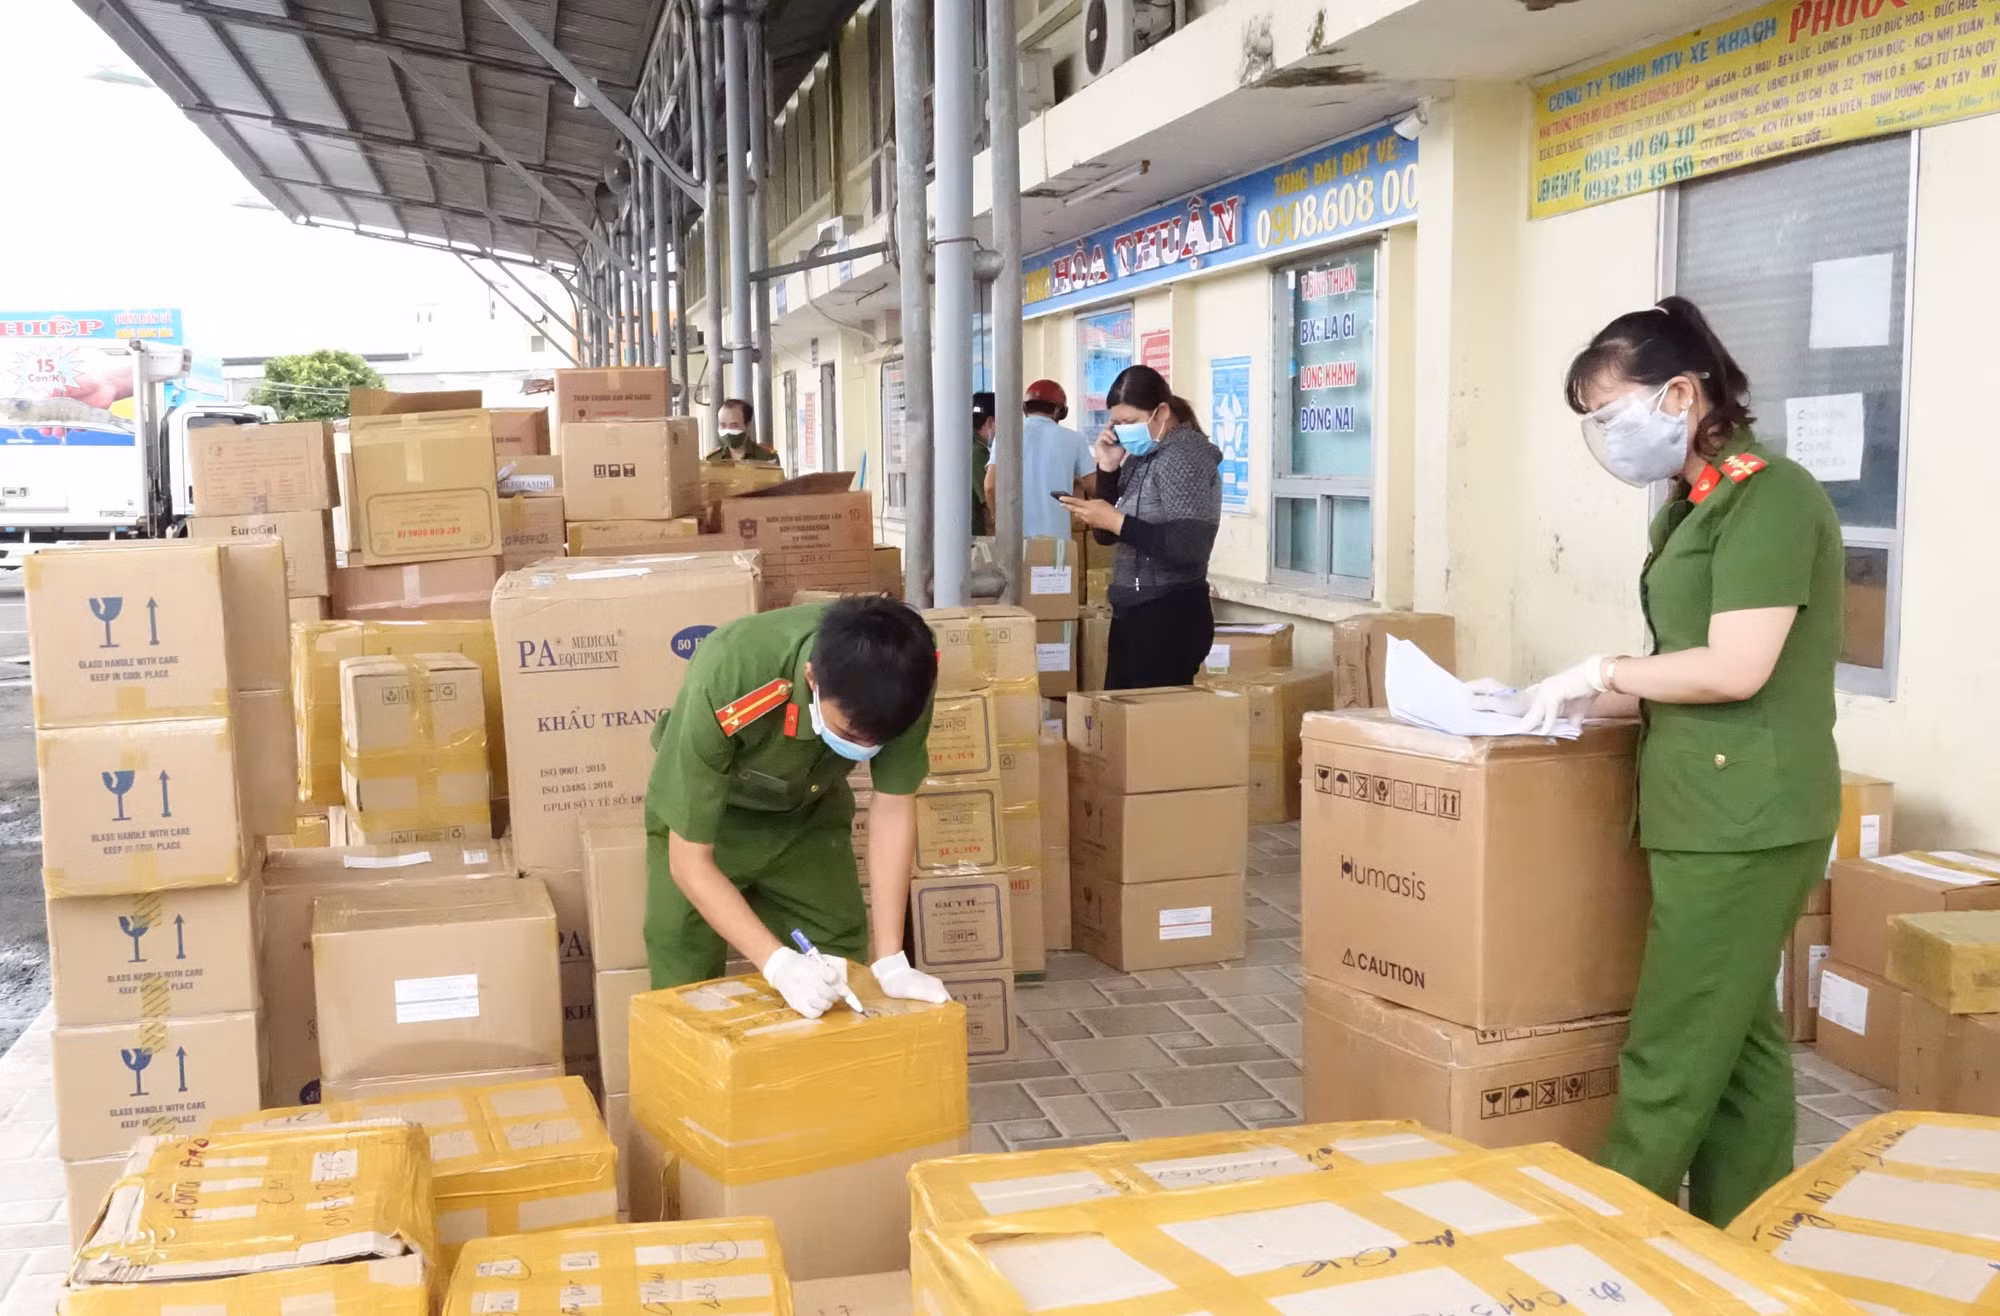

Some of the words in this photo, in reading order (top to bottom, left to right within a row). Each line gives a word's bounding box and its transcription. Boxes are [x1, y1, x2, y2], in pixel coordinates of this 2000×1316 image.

[1586, 79, 1602, 98] TY
[1608, 64, 1646, 92] TNHH
[1651, 48, 1683, 79] MTV
[1689, 40, 1710, 65] XE
[1257, 176, 1374, 250] 0908.608
[1113, 196, 1240, 271] THUẬN
[1323, 316, 1339, 341] LA
[1343, 312, 1355, 339] GI
[36, 358, 55, 373] 15
[27, 371, 67, 385] Con/Kg
[1301, 366, 1323, 390] LONG
[1335, 407, 1355, 432] NAI
[230, 523, 278, 538] EuroGel
[518, 638, 558, 669] PA
[571, 634, 619, 649] MEDICAL
[677, 639, 692, 651] 50
[78, 659, 103, 670] GLASS
[104, 657, 135, 668] HANDLE
[136, 655, 157, 667] WITH
[158, 654, 179, 666] CARE
[559, 650, 619, 667] EQUIPMENT
[90, 672, 110, 683] KEEP
[112, 671, 122, 682] IN
[122, 670, 142, 681] COOL
[144, 669, 169, 680] PLACE
[537, 706, 595, 733] KHẨU
[540, 768, 557, 779] ISO
[585, 763, 606, 774] 2015
[542, 785, 559, 795] ISO
[561, 782, 586, 793] 13485
[593, 780, 613, 790] 2016
[543, 803, 571, 813] GPLH
[91, 832, 116, 843] GLASS
[117, 830, 146, 841] HANDLE
[148, 828, 169, 838] WITH
[170, 826, 191, 837] CARE
[103, 844, 123, 855] KEEP
[156, 841, 182, 851] PLACE
[1341, 854, 1426, 901] Humasis
[107, 972, 132, 983] GLASS
[163, 969, 183, 980] WITH
[184, 968, 204, 978] CARE
[1358, 953, 1425, 989] CAUTION
[119, 984, 138, 994] KEEP
[171, 981, 194, 991] PLACE
[110, 1106, 133, 1117] GLASS
[135, 1104, 163, 1115] HANDLE
[165, 1102, 185, 1112] WITH
[186, 1100, 207, 1111] CARE
[121, 1118, 140, 1129] KEEP
